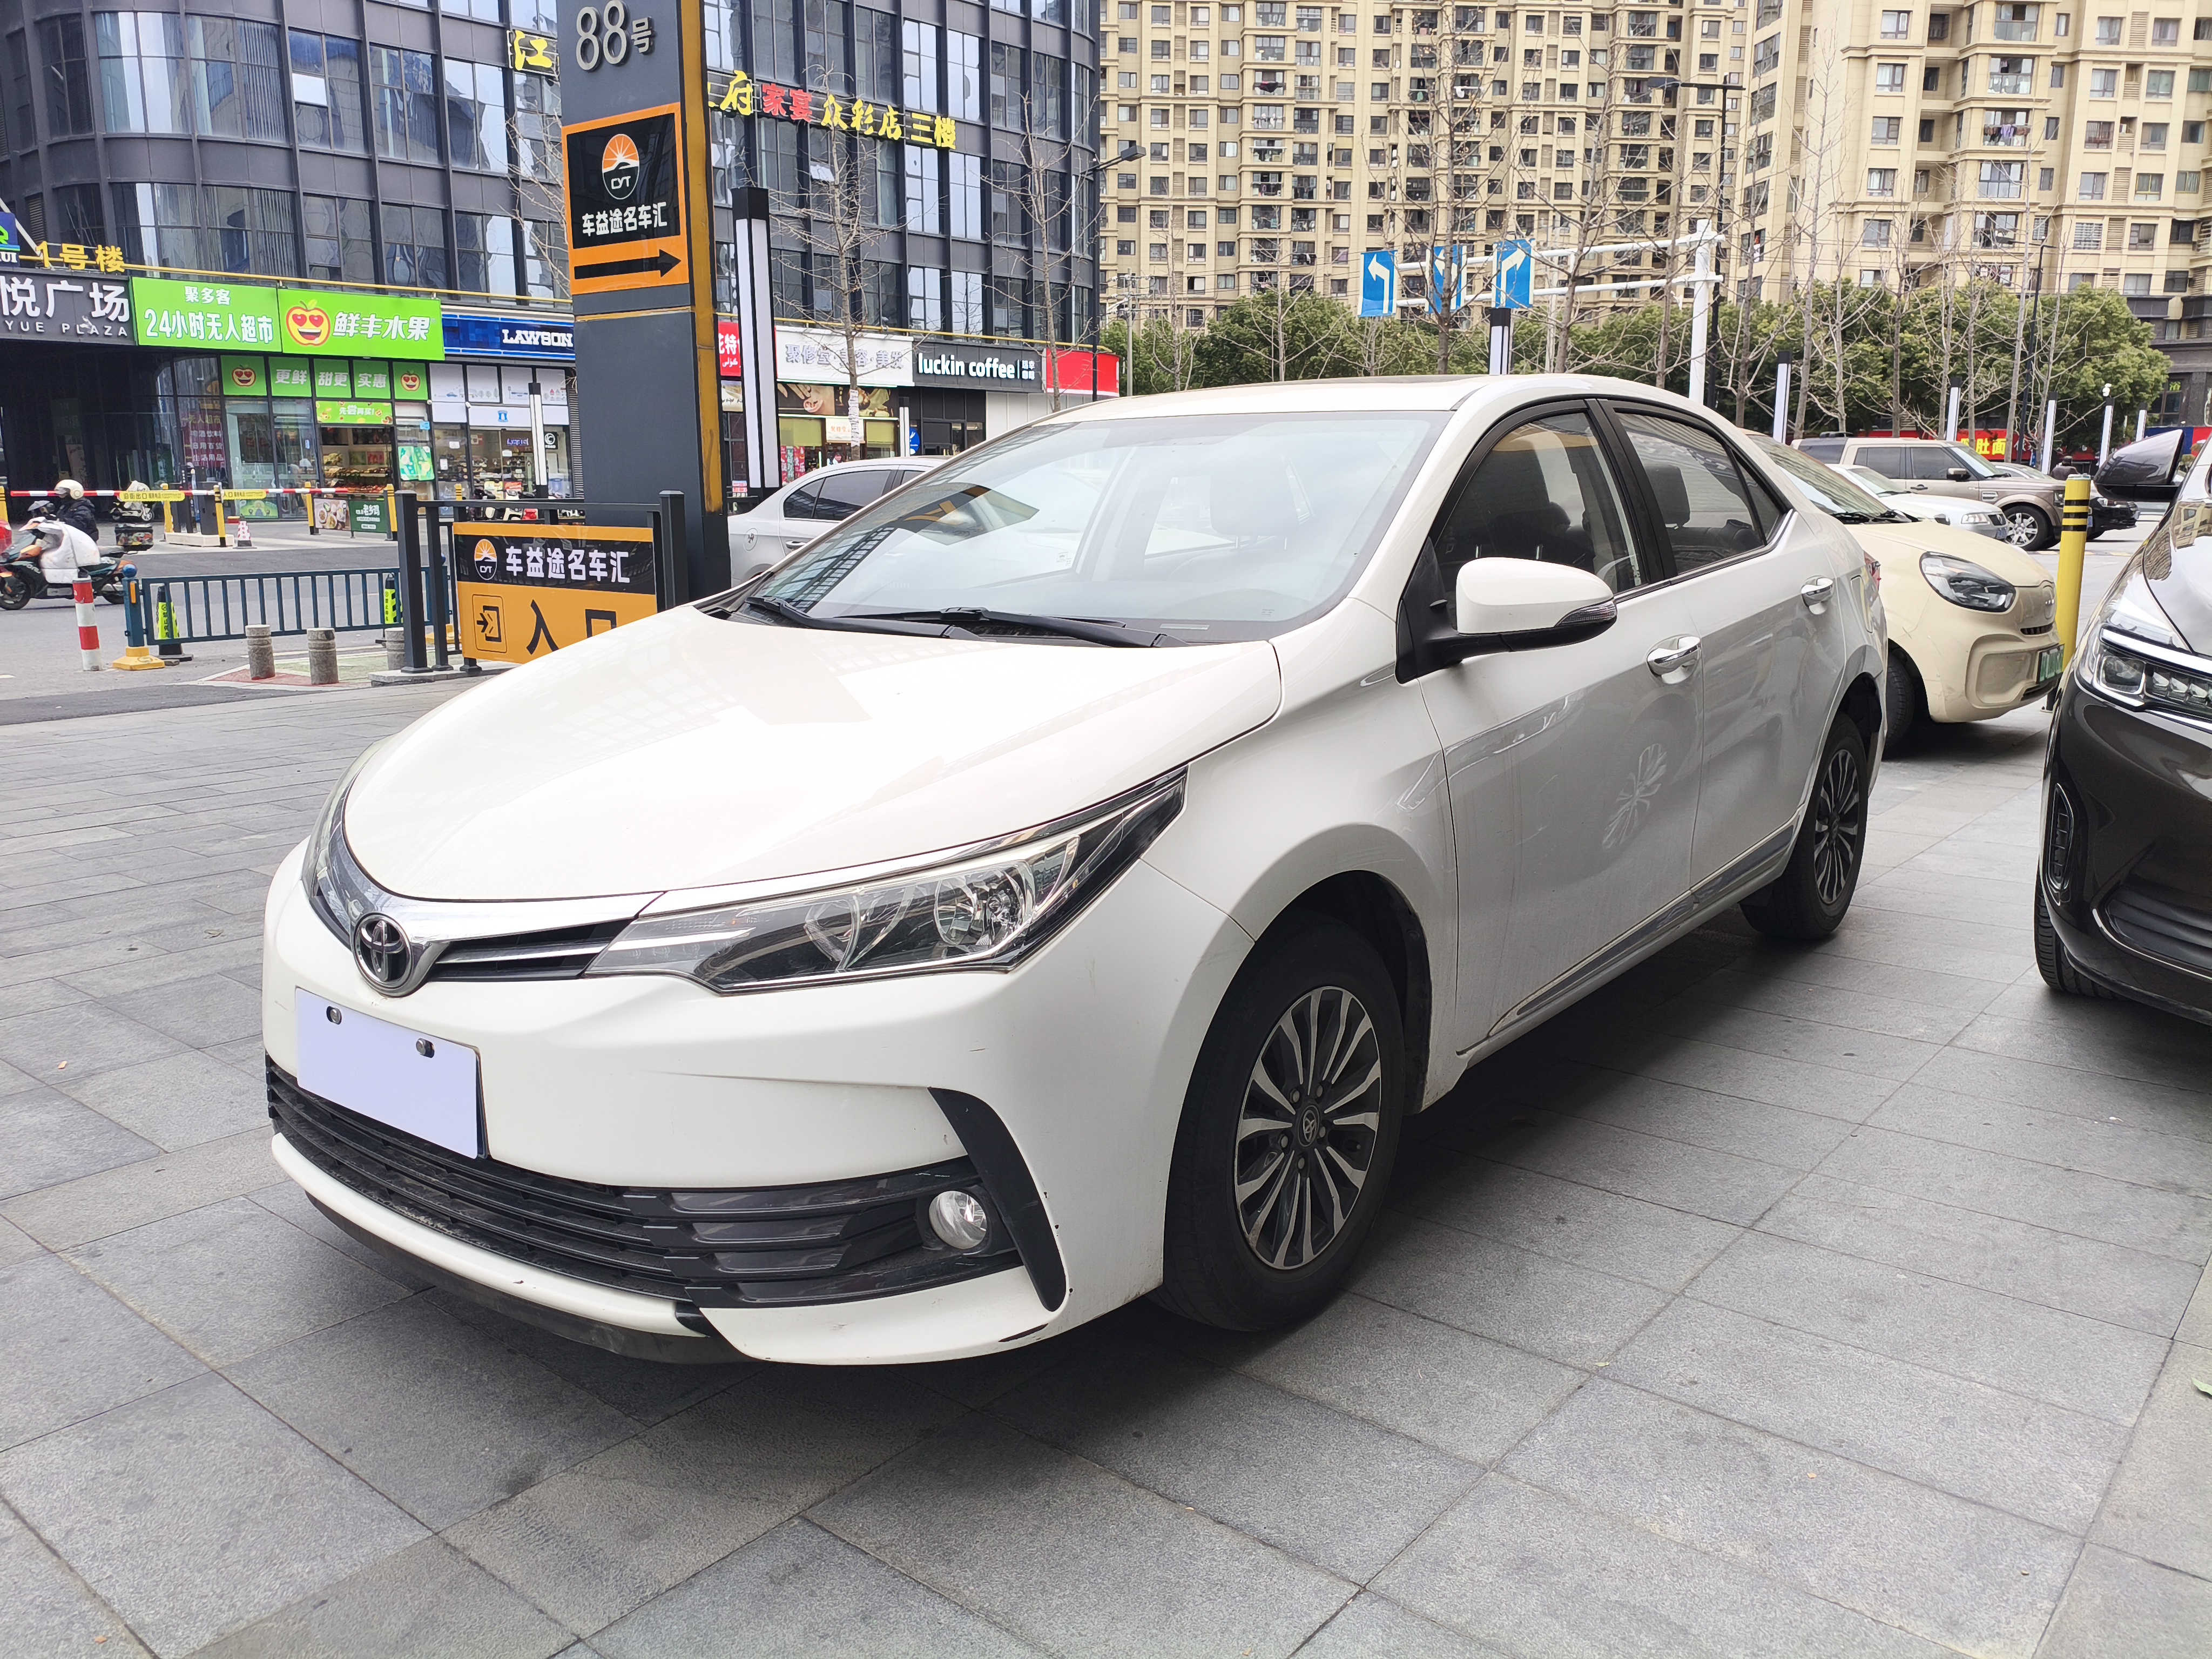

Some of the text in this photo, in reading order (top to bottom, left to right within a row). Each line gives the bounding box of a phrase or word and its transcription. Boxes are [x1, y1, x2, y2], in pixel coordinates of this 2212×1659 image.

[576, 0, 652, 71] 88号
[582, 201, 667, 237] 车益途名车汇
[0, 252, 18, 264] UI
[36, 241, 125, 273] 1号楼
[0, 275, 130, 322] 悦广场
[184, 286, 231, 306] 聚多客
[5, 320, 128, 336] YUE PLAZA
[144, 308, 274, 344] 24小时无人超市
[333, 312, 430, 341] 鲜丰水果
[502, 329, 573, 347] LAWSON
[275, 369, 387, 388] 更鲜 甜更 实惠
[918, 353, 1015, 379] luckin coffee
[505, 545, 630, 584] 车益途名车汇
